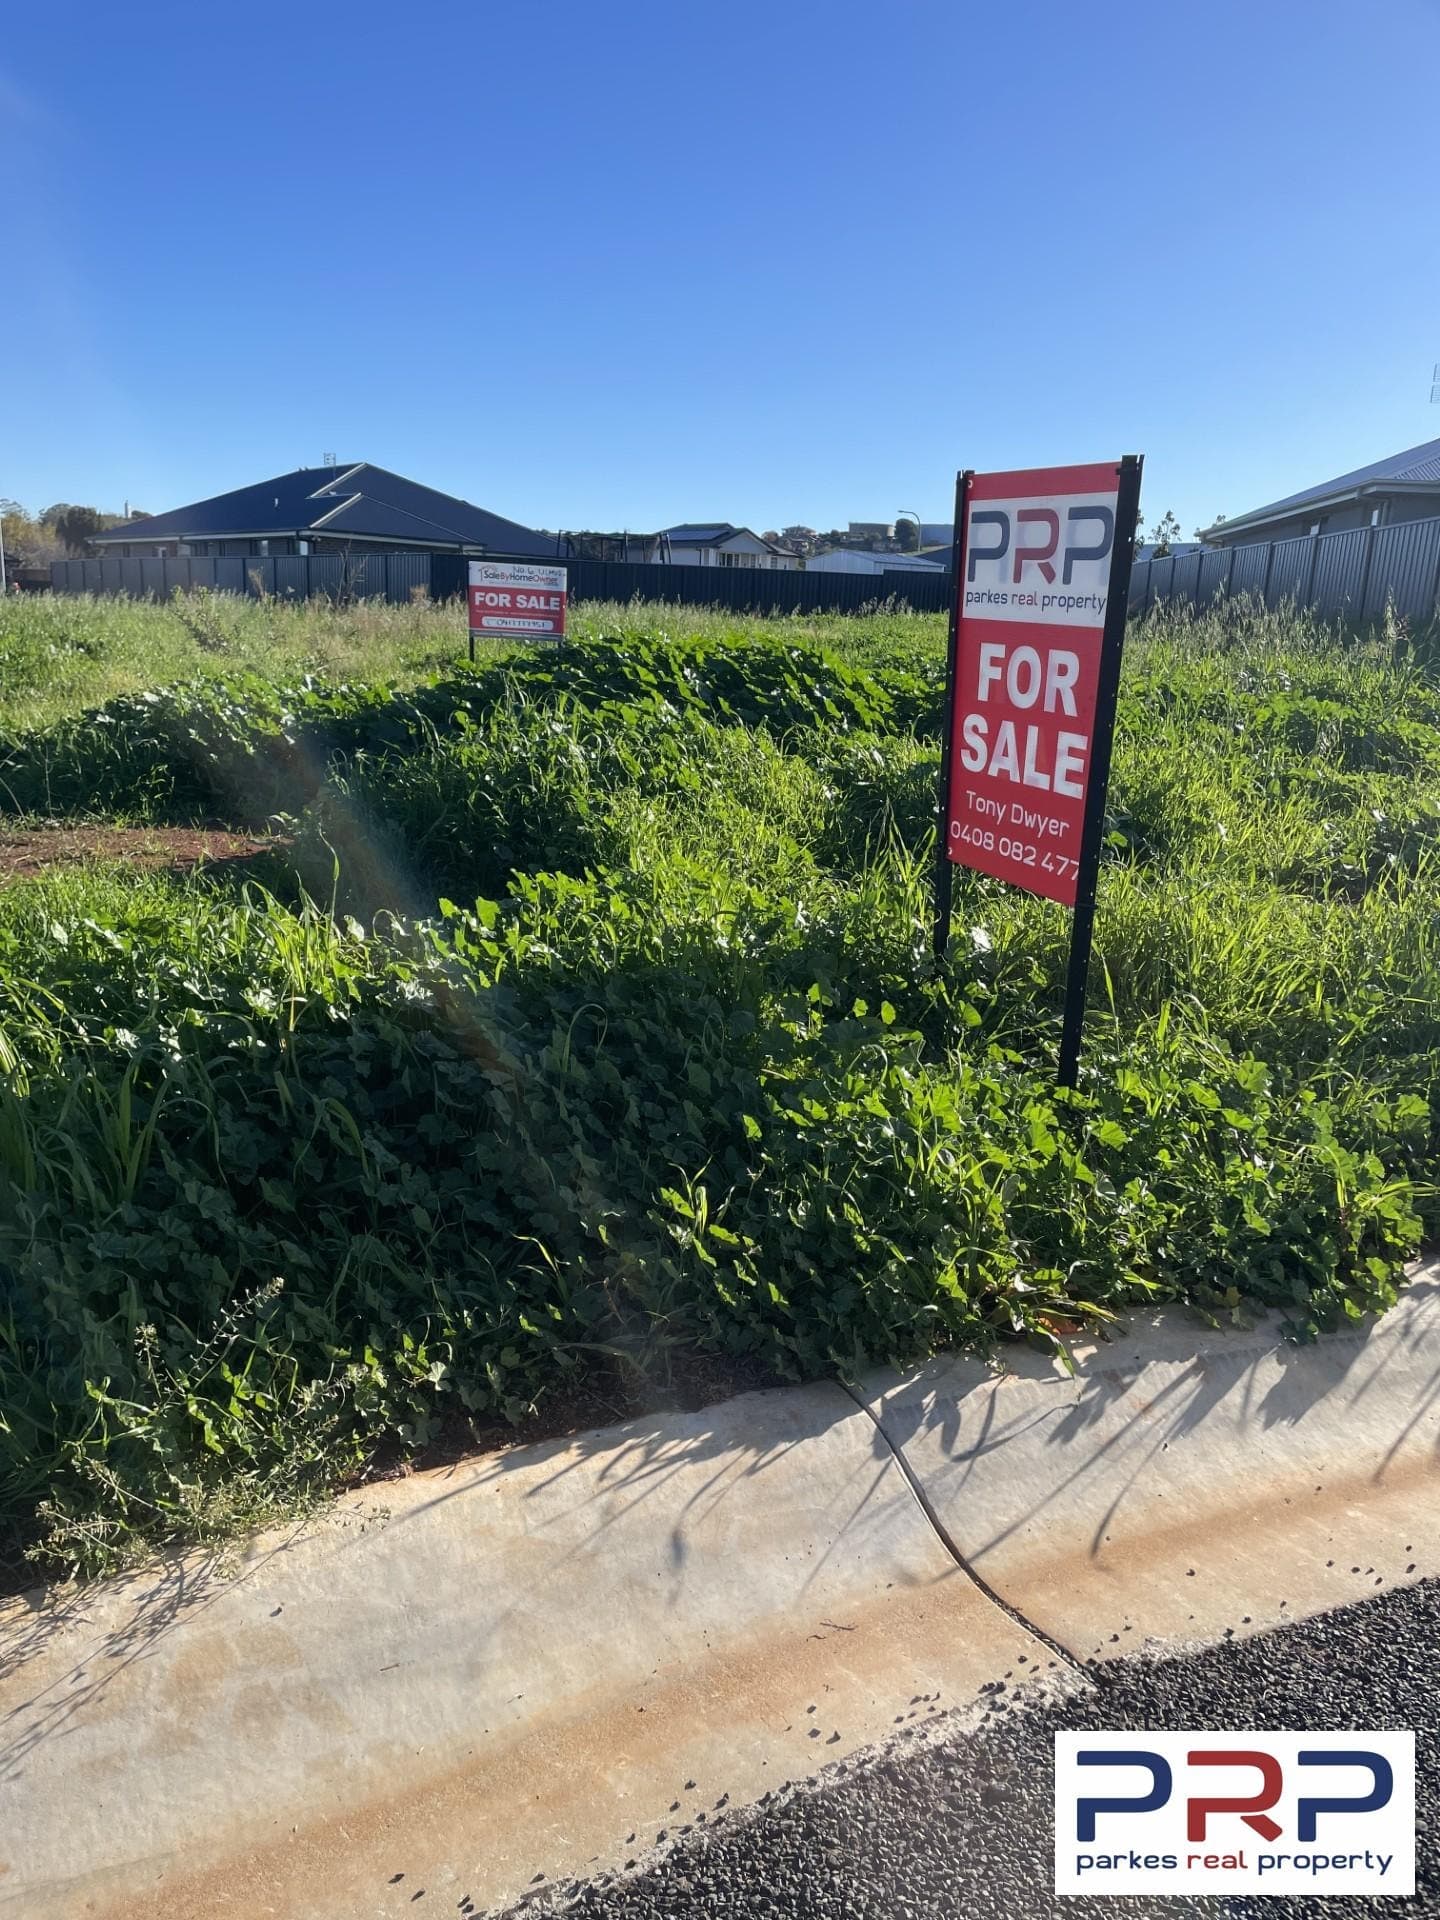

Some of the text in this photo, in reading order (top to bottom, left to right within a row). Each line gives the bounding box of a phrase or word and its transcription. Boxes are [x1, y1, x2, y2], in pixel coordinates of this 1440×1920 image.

[967, 505, 1115, 585] PRP
[474, 591, 561, 611] FOR SALE
[966, 588, 1107, 616] parkes real property
[977, 642, 1080, 717] FOR
[960, 713, 1089, 800] SALE
[966, 790, 1070, 838] Tony Dwyer
[950, 820, 1080, 881] 0408 082 477
